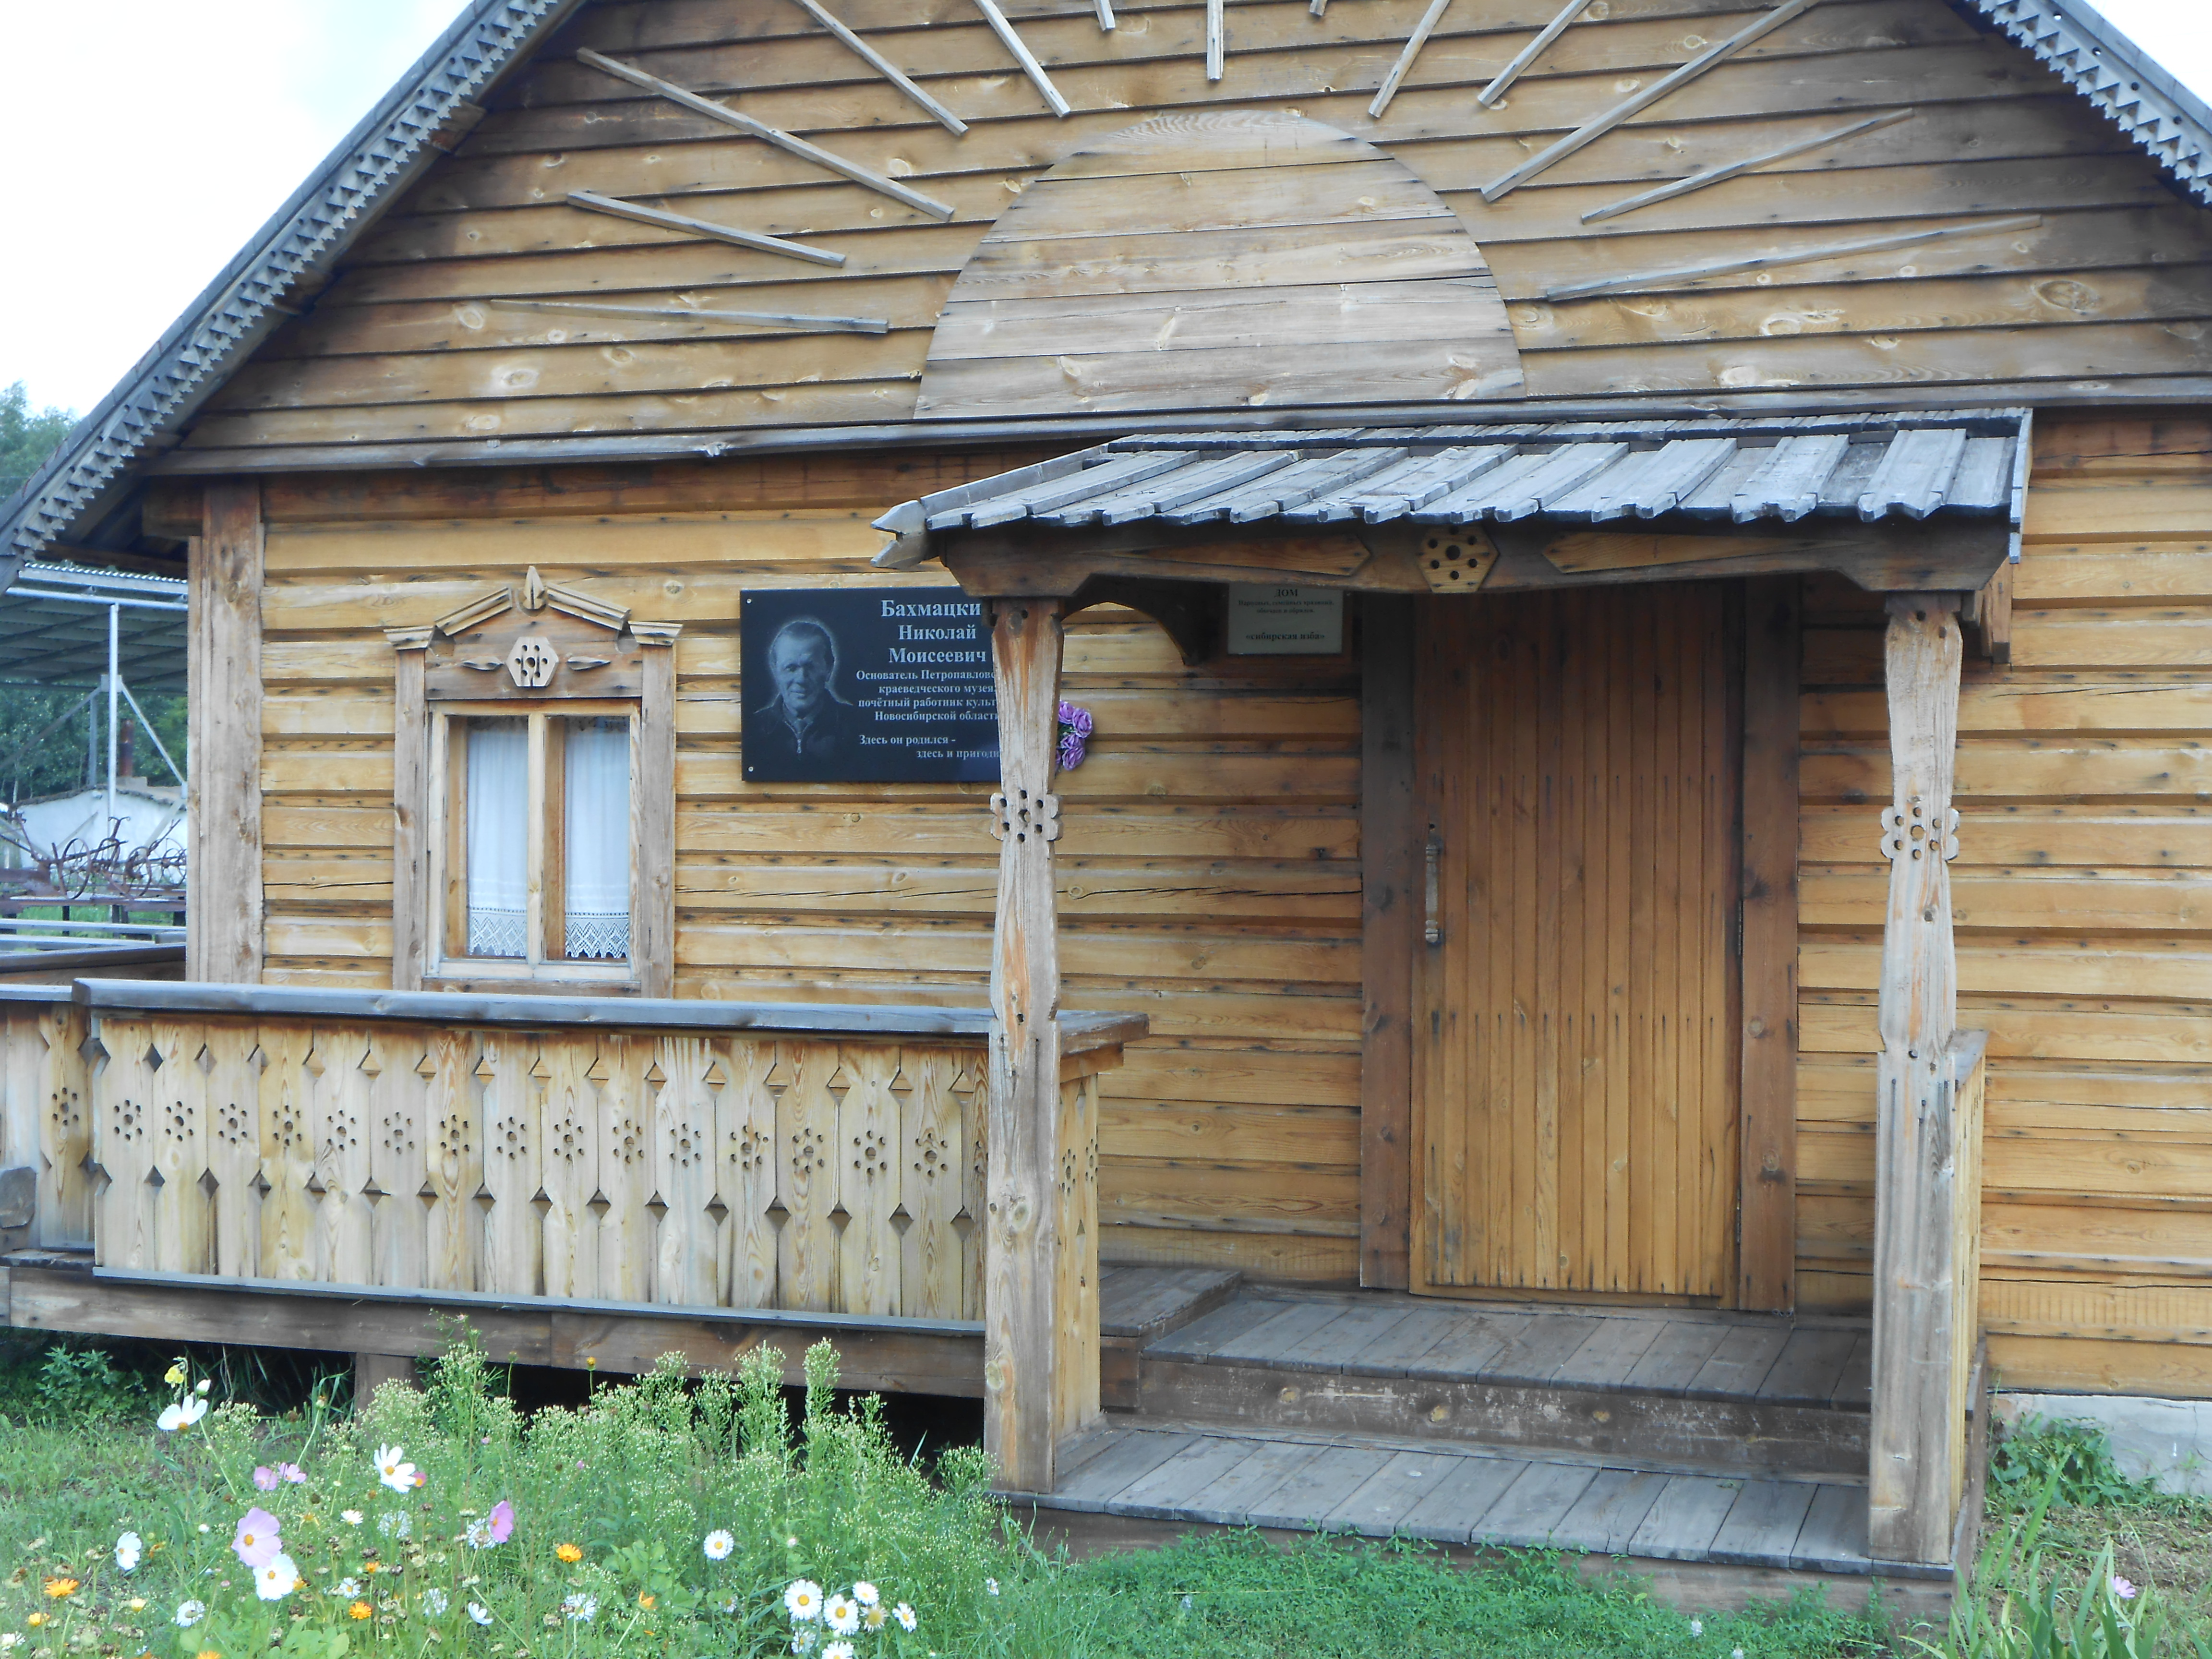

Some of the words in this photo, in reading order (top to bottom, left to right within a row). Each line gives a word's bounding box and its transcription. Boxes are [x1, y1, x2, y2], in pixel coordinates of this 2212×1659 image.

[1274, 589, 1298, 597] ДОМ
[881, 600, 981, 617] Бахмацки
[898, 624, 976, 640] Николай
[1246, 632, 1297, 641] «сибирская
[889, 648, 986, 663] Моисеевич
[856, 670, 918, 680] Основатель
[921, 670, 995, 682] Петропавловс
[878, 685, 961, 696] краеведческого
[858, 697, 910, 707] почётный
[914, 697, 963, 709] работник
[966, 699, 997, 709] культ
[875, 711, 956, 723] Новосибирской
[859, 734, 887, 745] Здесь
[906, 736, 949, 746] родился
[916, 750, 943, 758] здесь
[956, 750, 999, 760] пригоди
